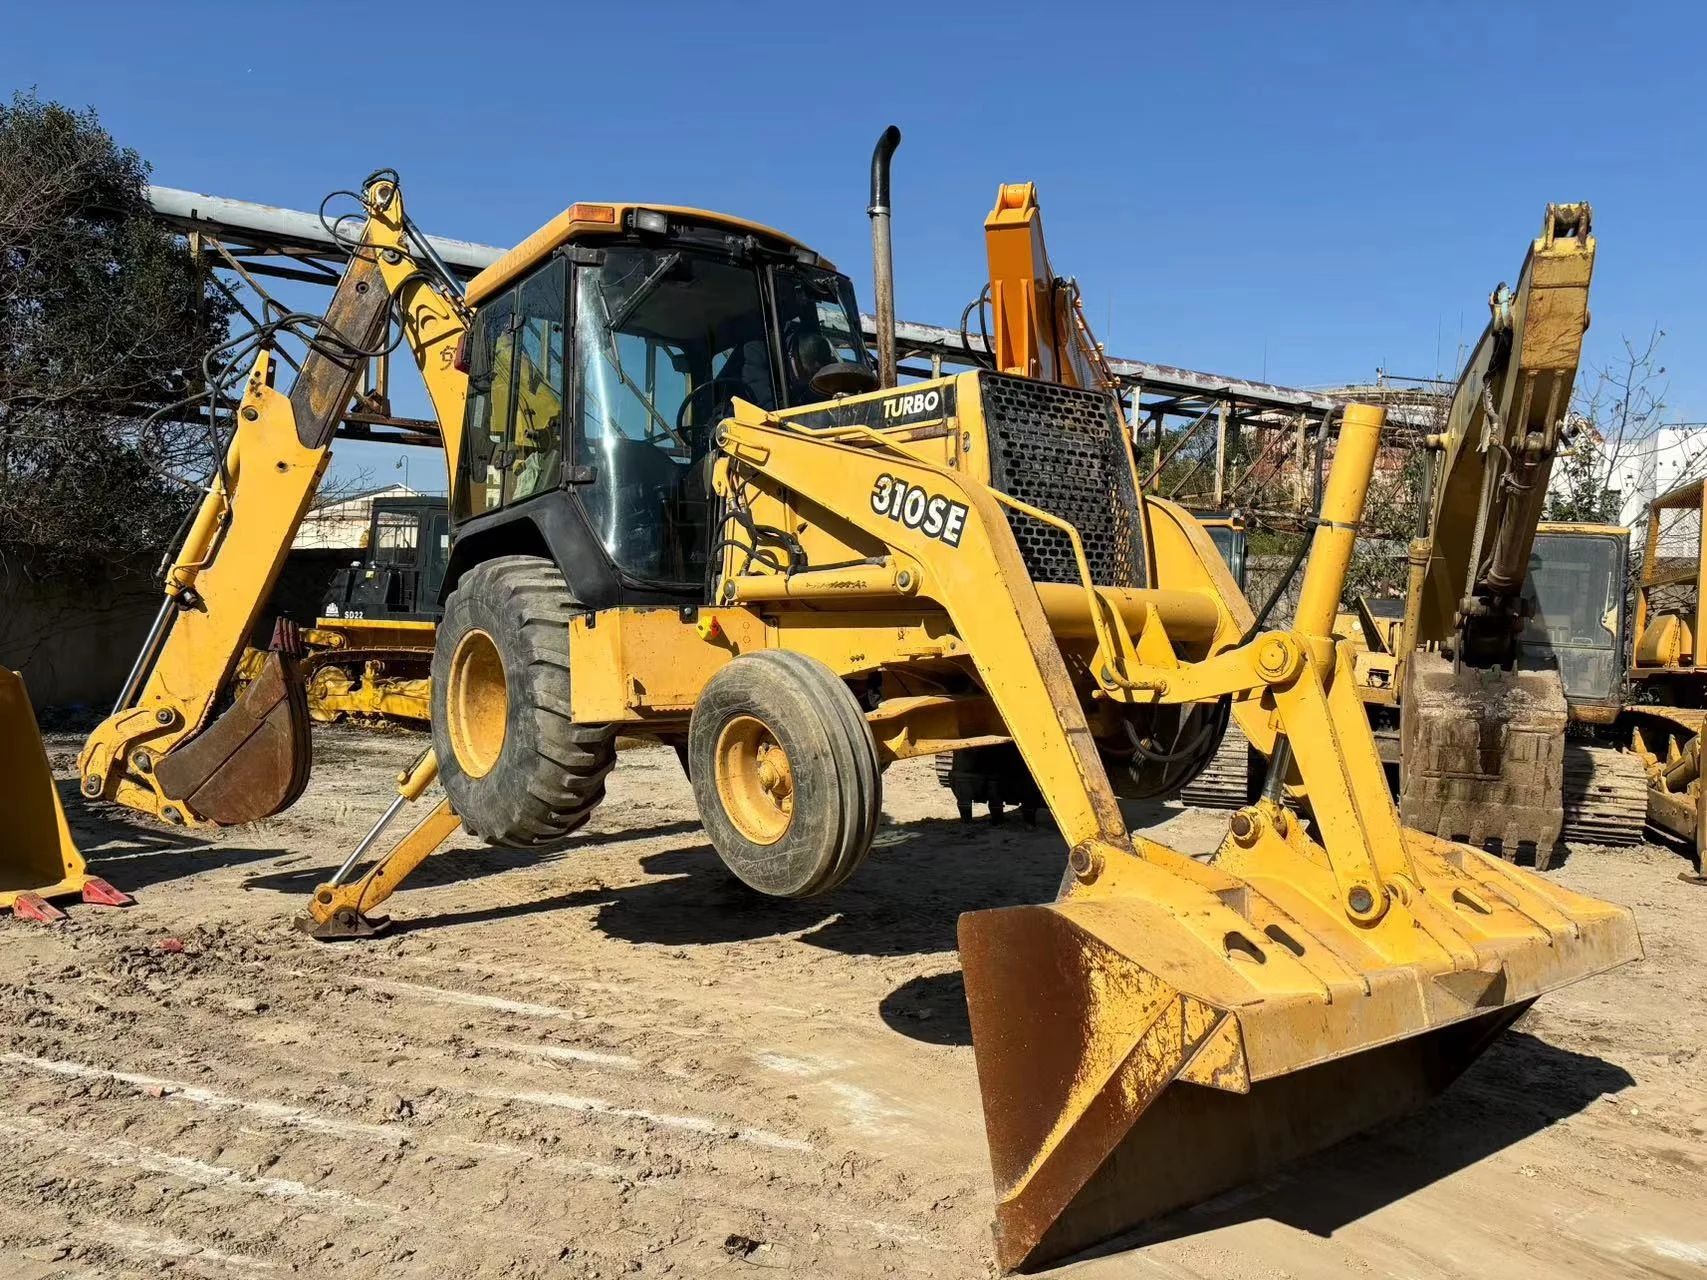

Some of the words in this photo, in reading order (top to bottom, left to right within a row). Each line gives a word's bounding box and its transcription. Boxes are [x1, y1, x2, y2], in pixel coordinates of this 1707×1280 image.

[883, 391, 939, 419] TURBO
[871, 473, 969, 548] 310SE
[344, 611, 364, 619] SD22
